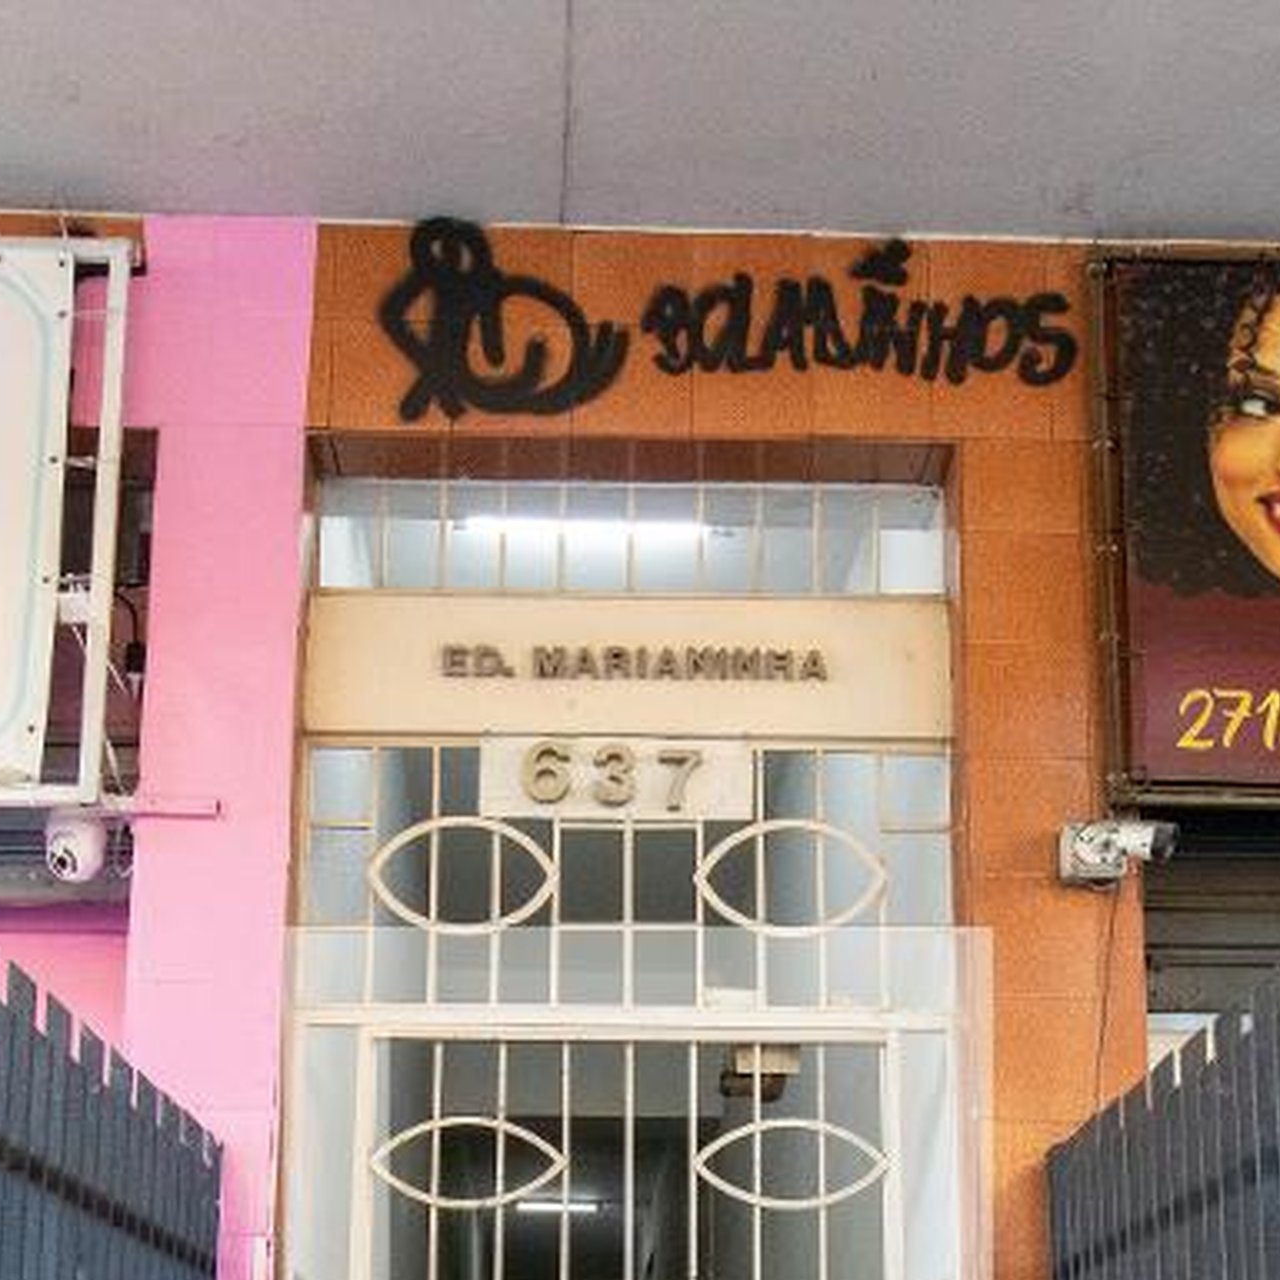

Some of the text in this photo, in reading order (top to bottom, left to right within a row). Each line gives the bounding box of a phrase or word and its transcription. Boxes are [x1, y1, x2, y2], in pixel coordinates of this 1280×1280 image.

[440, 643, 829, 682] ED. MARIANINHA
[523, 740, 704, 811] 637
